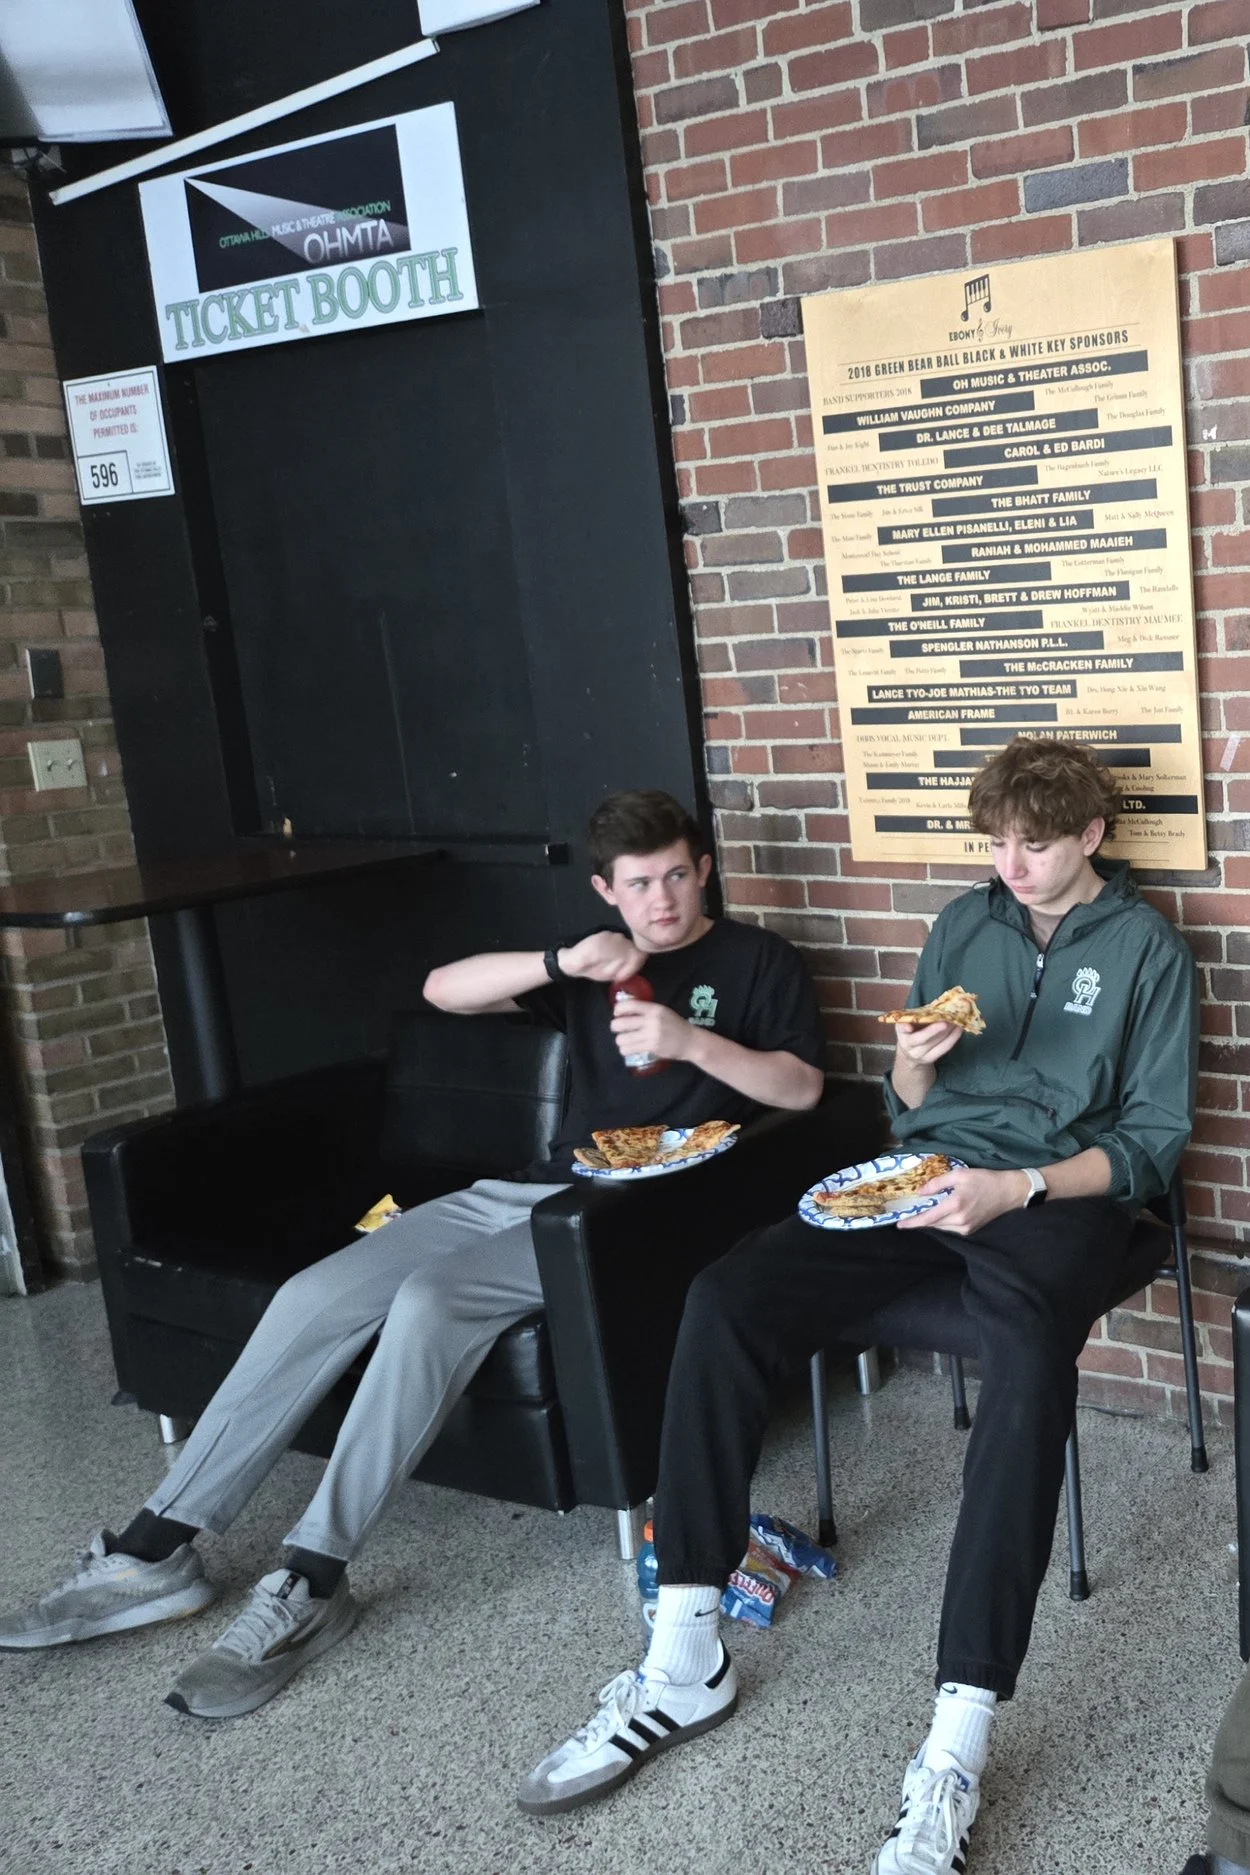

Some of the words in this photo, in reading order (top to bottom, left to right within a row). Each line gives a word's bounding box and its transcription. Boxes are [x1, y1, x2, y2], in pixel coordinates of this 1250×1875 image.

[302, 213, 335, 230] THEATRE
[304, 218, 393, 264] OHMTA
[165, 278, 300, 350] TICKET
[306, 247, 464, 326] BOOTH
[949, 330, 976, 342] EBONY
[848, 365, 872, 380] 2018
[875, 361, 905, 376] GREEN
[908, 357, 933, 372] BEAR
[936, 354, 960, 368] BALL
[963, 348, 996, 364] BLACK
[1000, 349, 1006, 360] &
[1010, 342, 1043, 358] WHITE
[1047, 339, 1066, 353] KEY
[1070, 330, 1128, 350] SPONSORS
[953, 379, 969, 390] OH
[971, 374, 1005, 388] MUSIC
[1008, 373, 1016, 383] &
[1018, 366, 1068, 382] THEATER
[1071, 361, 1111, 375] ASSOC.
[75, 394, 88, 406] THE
[88, 388, 120, 402] MAXIMUM
[122, 384, 149, 397] NUMBER
[90, 410, 98, 421] OF
[100, 405, 137, 420] OCCUPANTS
[857, 412, 899, 426] WILLIAM
[901, 407, 943, 421] VAUGHN
[945, 400, 995, 416] COMPANY
[94, 424, 128, 439] PERMITTED
[917, 433, 934, 443] DR.
[936, 428, 970, 441] LANCE
[972, 427, 980, 437] &
[983, 424, 1004, 436] DEE
[1006, 418, 1056, 433] TALMAGE
[1004, 445, 1040, 458] CAROL
[1043, 444, 1051, 454] &
[1054, 442, 1069, 453] ED
[1071, 438, 1105, 451] BARDI
[90, 462, 118, 488] 596
[877, 484, 897, 495] THE
[899, 481, 932, 493] TRUST
[934, 476, 983, 490] COMPANY
[991, 497, 1013, 508] THE
[1015, 494, 1050, 506] BHATT
[1053, 490, 1091, 503] FAMILY
[893, 529, 920, 539] MARY
[923, 526, 954, 537] ELLEN
[956, 521, 1012, 535] PISANELLI,
[1015, 518, 1045, 530] ELENI
[1049, 518, 1057, 528] &
[1060, 516, 1078, 527] LIA
[972, 545, 1011, 557] RANIAH
[1014, 544, 1022, 554] &
[1024, 540, 1088, 554] MOHAMMED
[1090, 536, 1133, 549] MAAIEH
[897, 575, 917, 585] THE
[919, 573, 953, 584] LANGE
[955, 570, 991, 582] FAMILY
[923, 597, 943, 607] JIM,
[945, 595, 982, 605] KRISTI,
[984, 592, 1018, 604] BRETT
[1020, 592, 1029, 601] &
[1031, 590, 1062, 601] DREW
[1064, 587, 1117, 599] HOFFMAN
[888, 622, 908, 632] THE
[910, 620, 948, 631] O'NEILL
[950, 618, 985, 629] FAMILY
[922, 641, 974, 653] SPENGLER
[976, 639, 1039, 650] NATHANSON
[1041, 638, 1068, 648] P.L.L.
[1004, 663, 1025, 672] THE
[1027, 660, 1093, 672] McCRACKEN
[1095, 658, 1134, 669] FAMILY
[873, 690, 904, 699] LANCE
[906, 688, 947, 698] TYO-JOE
[949, 686, 1017, 697] MATHIAS-THE
[1019, 685, 1040, 695] TYO
[1042, 684, 1071, 695] TEAM
[908, 710, 959, 720] AMERICAN
[961, 709, 996, 719] FRAME
[1056, 730, 1118, 740] PATERWICH
[918, 776, 938, 786] THE
[940, 776, 974, 786] HAJJA
[1122, 800, 1146, 809] LTD.
[926, 820, 943, 830] DR.
[946, 820, 953, 830] &
[964, 842, 975, 853] IN
